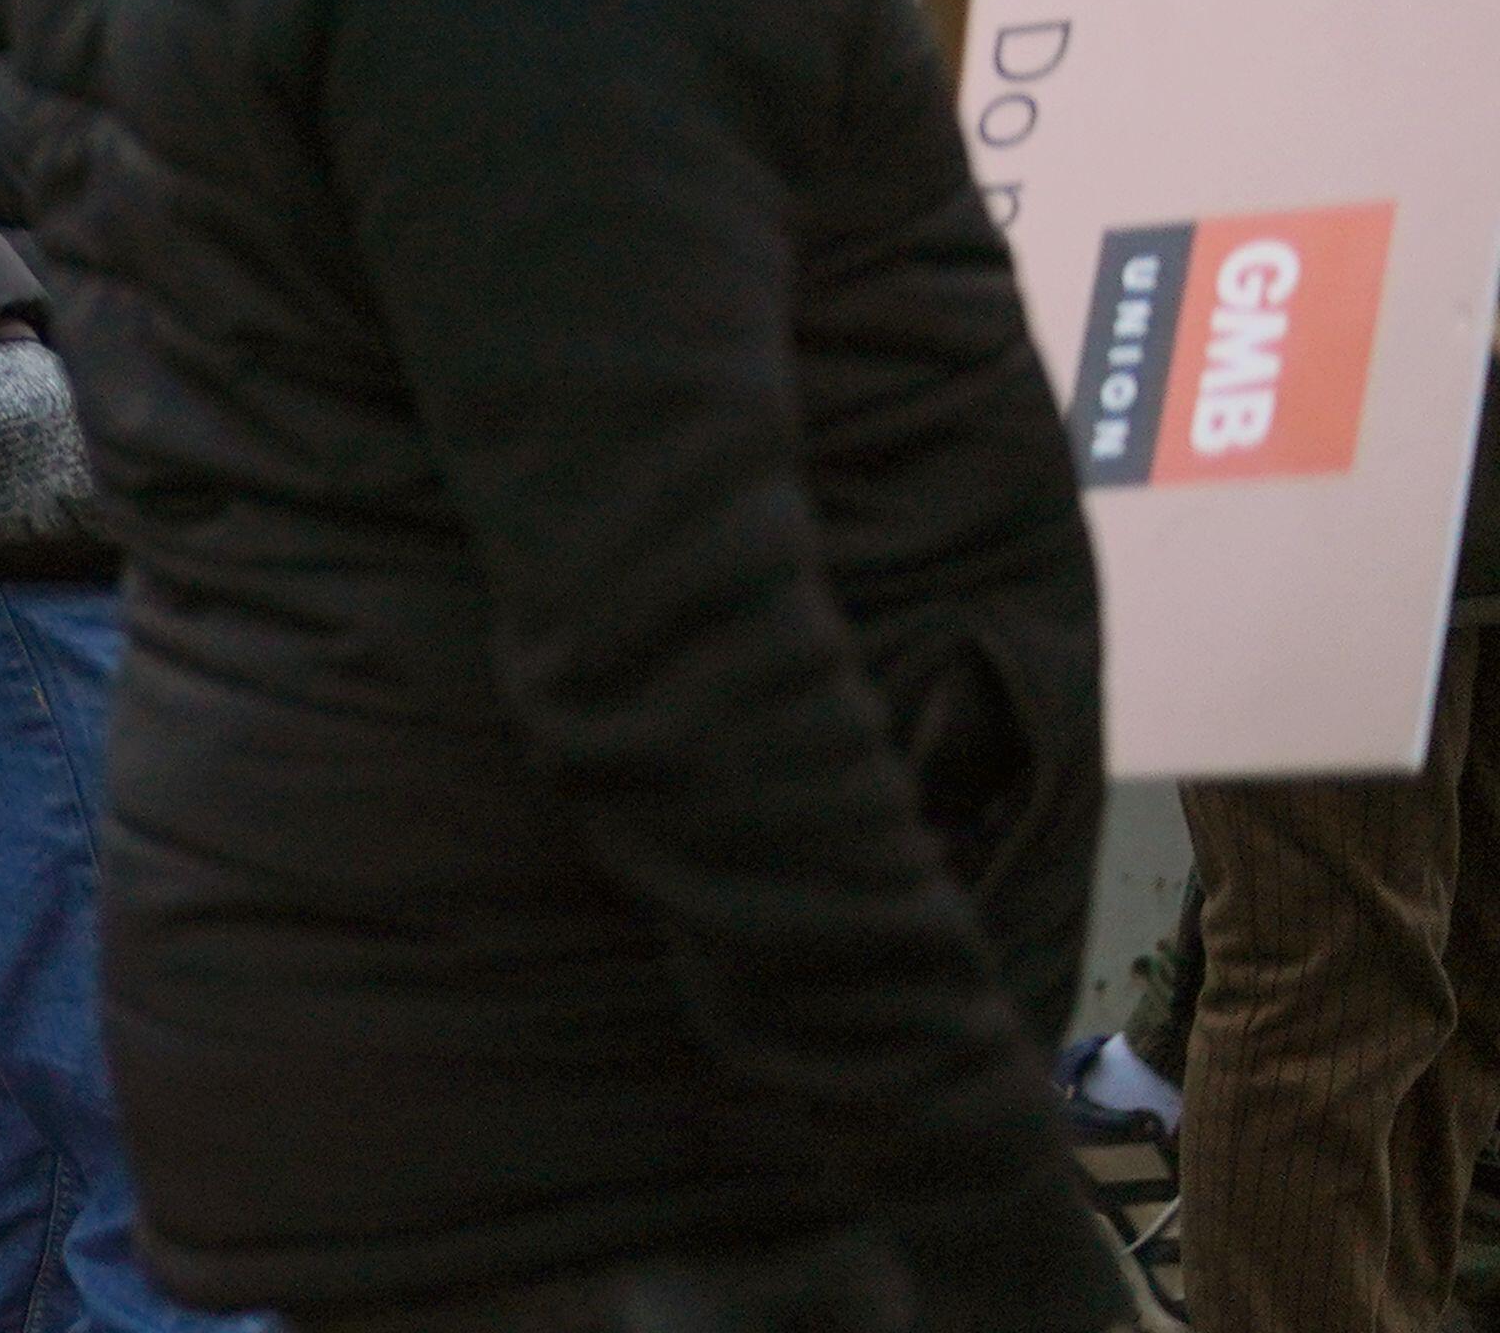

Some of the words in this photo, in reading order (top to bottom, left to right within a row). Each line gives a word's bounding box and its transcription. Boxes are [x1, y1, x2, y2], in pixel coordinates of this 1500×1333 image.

[978, 19, 1070, 149] Do
[1091, 254, 1161, 461] UNION
[1190, 238, 1300, 459] GMB
